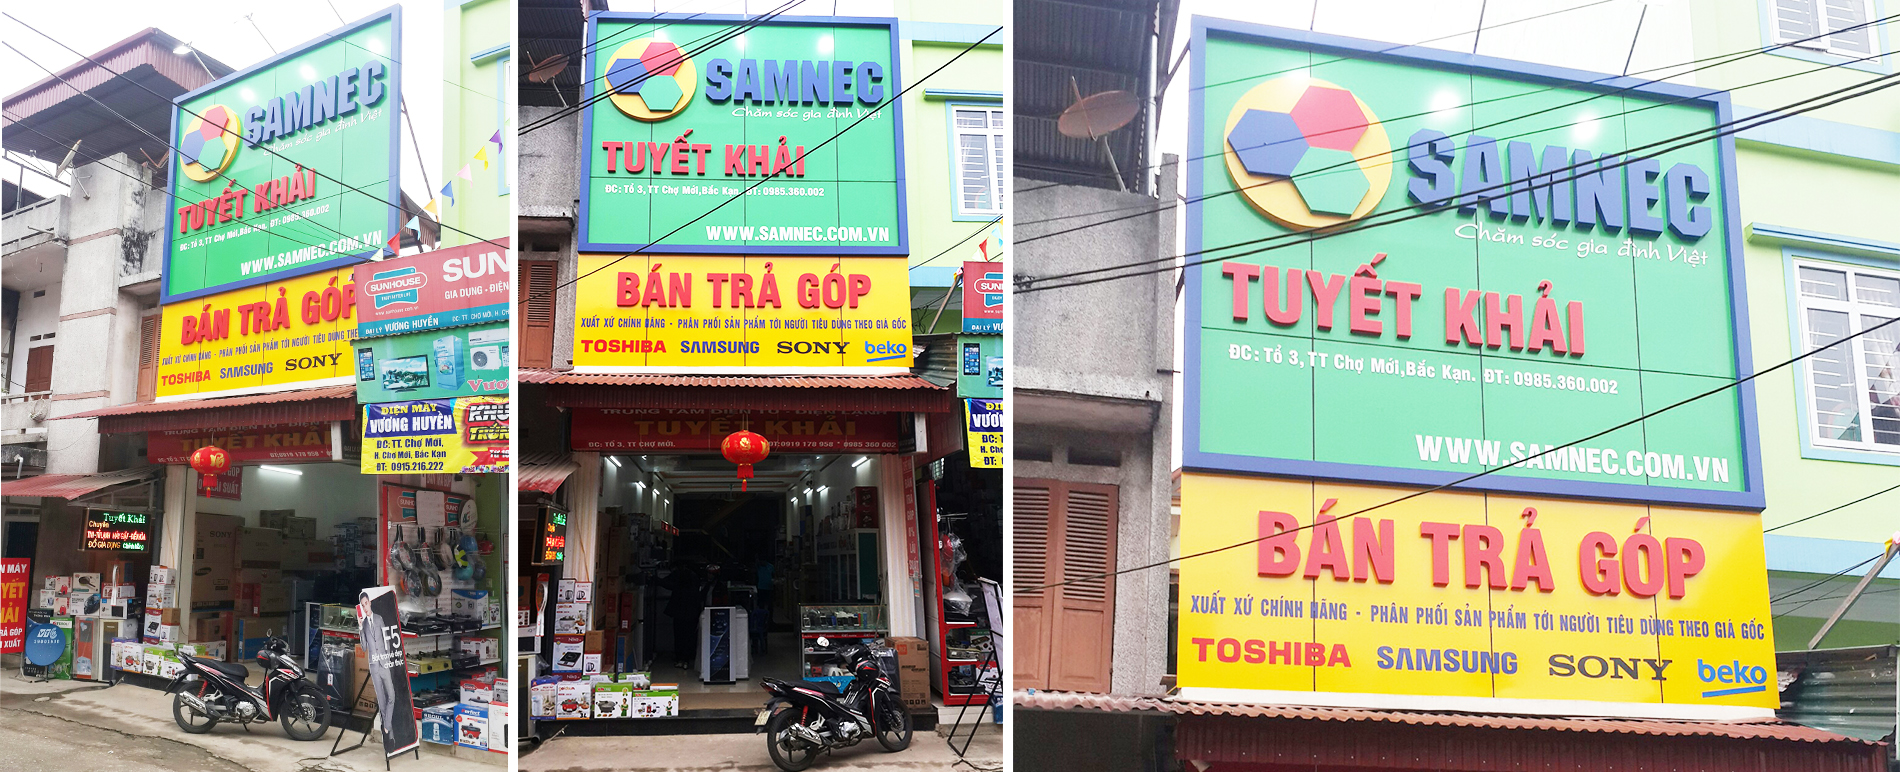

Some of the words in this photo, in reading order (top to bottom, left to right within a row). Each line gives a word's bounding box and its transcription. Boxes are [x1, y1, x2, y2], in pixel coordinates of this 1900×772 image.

[705, 58, 883, 107] SAMNEC
[242, 59, 385, 149] SAMNEC
[731, 107, 772, 118] Chăm
[776, 107, 798, 118] sóc
[802, 109, 822, 121] gia
[826, 106, 853, 119] đình
[857, 108, 882, 121] Việt
[316, 127, 331, 142] gia
[335, 116, 357, 133] đình
[360, 109, 383, 124] Việt
[602, 129, 712, 175] TUYẾT
[724, 135, 805, 178] KHẢI
[605, 185, 622, 194] ĐC:
[624, 184, 634, 194] Tổ
[648, 186, 659, 194] TT
[661, 184, 680, 196] Chợ
[763, 187, 825, 197] 0985.360.002
[1407, 128, 1712, 242] SAMNEC
[178, 178, 248, 234] TUYẾT
[254, 163, 316, 213] KHẢI
[706, 225, 889, 243] WWW.SAMNEC.COM.VN
[1454, 223, 1525, 250] Chăm
[1531, 231, 1570, 251] sóc
[1577, 237, 1609, 259] gia
[1617, 237, 1661, 261] đình
[1665, 243, 1709, 268] Việt
[240, 230, 382, 276] WWW.SAMNEC.COM.VN
[370, 276, 421, 293] SUNHOUSE
[444, 290, 458, 300] GIA
[460, 286, 483, 299] DỤNG
[617, 263, 692, 308] BÁN
[706, 261, 782, 309] TRẢ
[797, 263, 872, 309] GÓP
[181, 304, 230, 345] BÁN
[238, 286, 290, 336] TRẢ
[301, 276, 356, 326] GÓP
[1222, 253, 1422, 339] TUYẾT
[1444, 280, 1585, 358] KHẢI
[385, 320, 409, 333] VƯƠNG
[412, 315, 439, 329] HUYỀN
[581, 315, 600, 328] XUẤT
[603, 315, 615, 328] XỨ
[618, 315, 642, 329] CHÍNH
[677, 317, 699, 329] PHÂN
[702, 313, 721, 329] PHỐI
[724, 314, 741, 329] SẢN
[744, 314, 766, 330] PHẨM
[769, 315, 782, 330] TỚI
[784, 316, 808, 330] NGƯỜI
[811, 316, 828, 330] TIÊU
[831, 316, 852, 330] DÙNG
[854, 319, 873, 330] THEO
[875, 316, 890, 330] GIÁ
[892, 314, 907, 330] GỐC
[291, 335, 310, 348] NGƯỜI
[313, 331, 325, 344] TIÊU
[581, 339, 667, 353] TOSHIBA
[680, 340, 760, 354] SAMSUNG
[777, 341, 850, 355] SONY
[865, 340, 907, 354] beko
[161, 370, 211, 387] TOSHIBA
[220, 361, 273, 379] SAMSUNG
[285, 353, 342, 372] SONY
[1228, 344, 1261, 363] ĐC:
[1263, 345, 1284, 365] Tổ
[1308, 350, 1328, 367] TT
[1333, 351, 1364, 374] Chợ
[1442, 362, 1476, 385] Kạn.
[1483, 367, 1510, 385] ĐT:
[1513, 370, 1619, 394] 0985.360.002
[381, 404, 409, 416] ĐIỆN
[412, 403, 438, 413] MÁY
[370, 416, 409, 433] VƯƠNG
[412, 411, 452, 431] HUYỀN
[634, 414, 754, 436] TUYẾT
[765, 415, 856, 436] KHẢI
[374, 451, 381, 459] H.
[382, 450, 396, 460] Chợ
[398, 449, 413, 459] Mới,
[415, 449, 429, 459] Bắc
[431, 449, 447, 460] Kạn
[404, 438, 422, 449] Chợ
[425, 437, 444, 448] Mới,
[980, 446, 988, 454] H.
[377, 462, 387, 471] ĐT:
[391, 461, 444, 471] 0915.216.222
[984, 456, 997, 466] ĐT:
[1415, 434, 1729, 483] WWW.SAMNEC.COM.VN
[209, 530, 232, 538] SONY
[1257, 498, 1395, 585] BÁN
[1420, 507, 1555, 589] TRẢ
[1579, 517, 1706, 600] GÓP
[1190, 590, 1226, 615] XUẤT
[1233, 594, 1254, 616] XỨ
[1260, 596, 1303, 619] CHÍNH
[1310, 599, 1347, 621] HÃNG
[1371, 602, 1409, 624] PHÂN
[1416, 602, 1448, 627] PHỐI
[1455, 603, 1482, 628] SẢN
[1489, 604, 1527, 630] PHẨM
[1533, 609, 1554, 631] TỚI
[1560, 610, 1600, 634] NGƯỜI
[1607, 614, 1634, 635] TIÊU
[1640, 617, 1674, 636] DÙNG
[1679, 620, 1710, 638] THEO
[1715, 618, 1735, 639] GIÁ
[1741, 616, 1765, 640] GỐC
[381, 624, 401, 651] F5
[1191, 637, 1352, 668] TOSHIBA
[1377, 646, 1518, 674] SAMSUNG
[1548, 654, 1672, 681] SONY
[1697, 658, 1767, 685] beko
